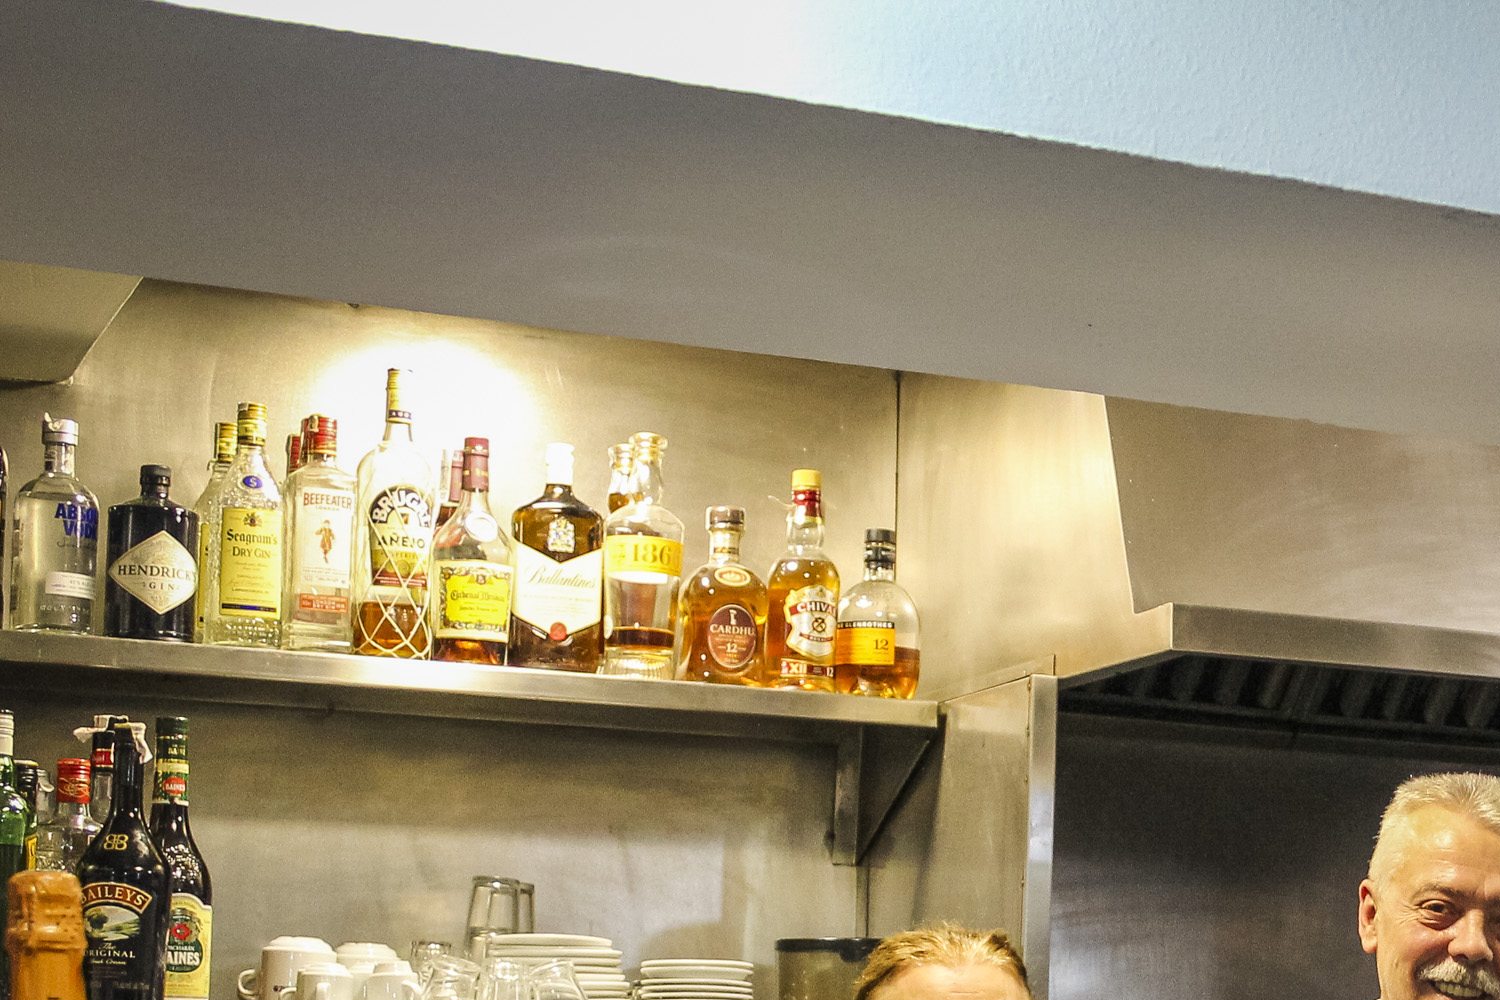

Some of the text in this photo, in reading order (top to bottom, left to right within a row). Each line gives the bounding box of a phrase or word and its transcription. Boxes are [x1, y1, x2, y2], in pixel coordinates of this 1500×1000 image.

[303, 492, 352, 509] BEEFEATER
[226, 528, 278, 546] Seagram's
[232, 547, 271, 558] DRY GIN
[117, 564, 198, 582] HENDRICK
[149, 581, 175, 591] GIN
[709, 623, 754, 636] CARDHU
[726, 642, 738, 653] 12
[873, 638, 889, 651] 12
[166, 952, 200, 966] AINES
